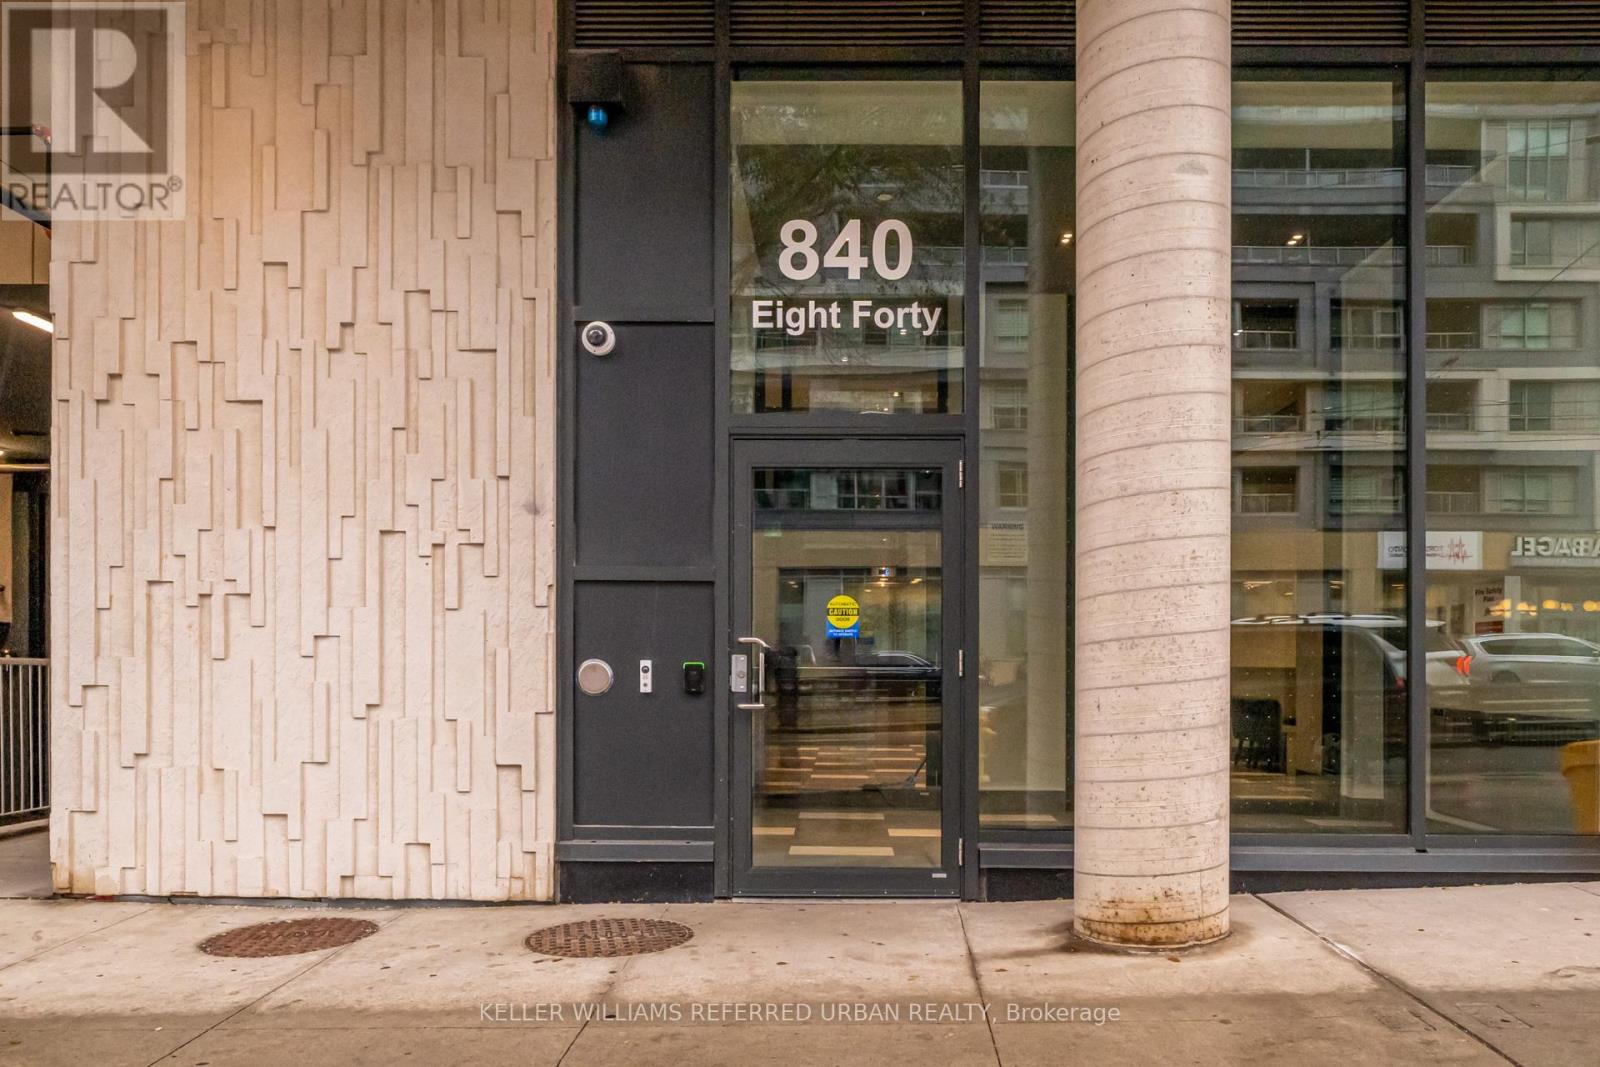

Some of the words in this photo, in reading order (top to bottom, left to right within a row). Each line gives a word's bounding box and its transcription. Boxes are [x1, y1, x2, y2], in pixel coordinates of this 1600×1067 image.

[778, 219, 913, 281] 840
[752, 301, 841, 336] Eight
[853, 301, 941, 336] Forty
[829, 608, 858, 616] CAUTION
